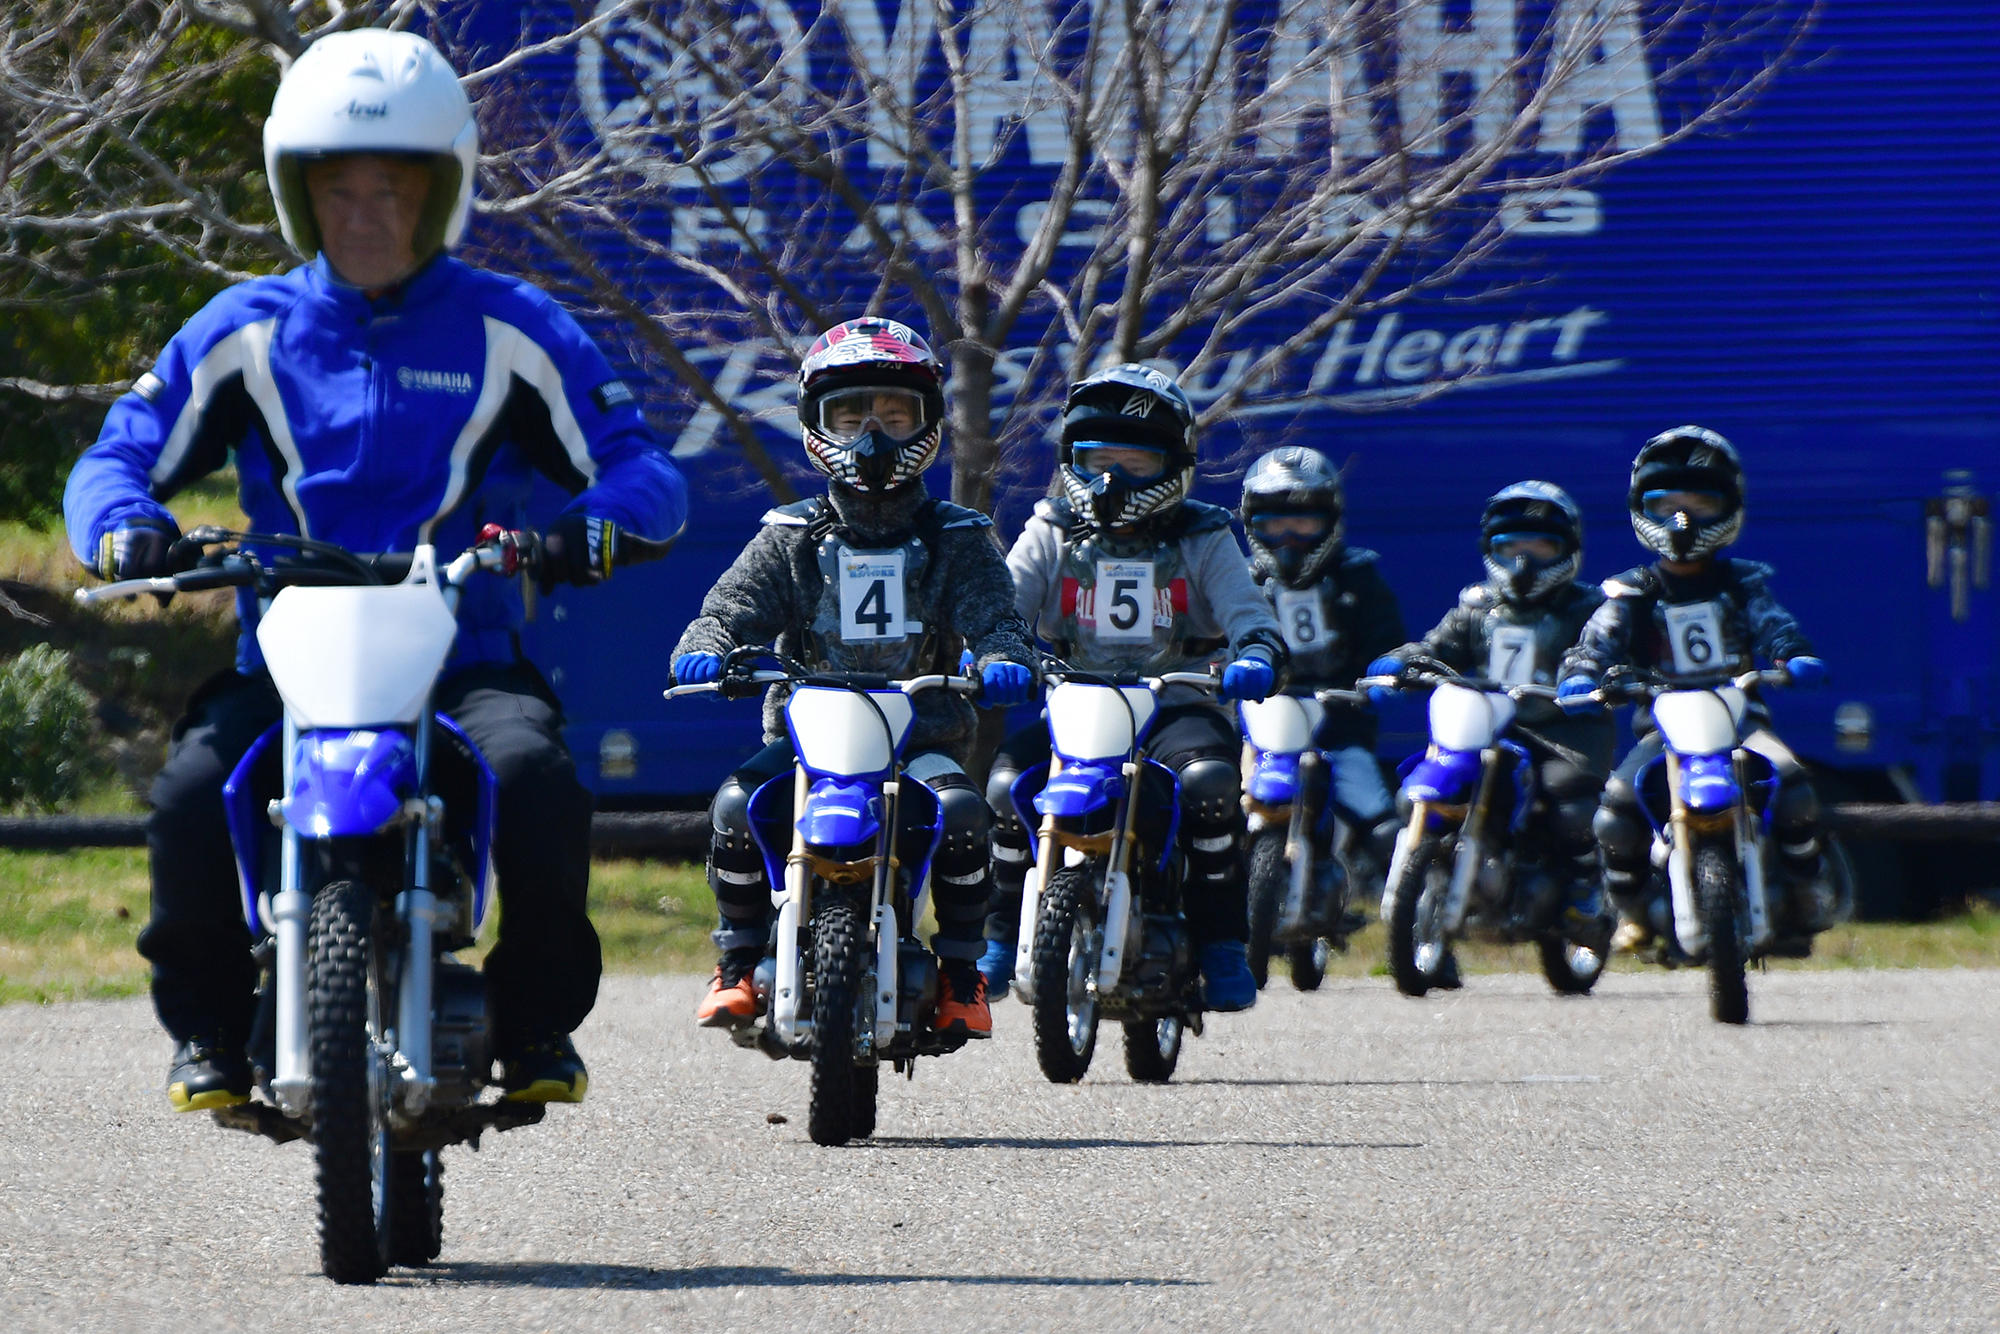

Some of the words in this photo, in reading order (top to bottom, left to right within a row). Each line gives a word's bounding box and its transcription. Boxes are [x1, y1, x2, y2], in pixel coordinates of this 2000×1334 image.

[1309, 304, 1608, 391] Heart
[413, 369, 473, 388] YAMAHA
[854, 579, 893, 636] 4
[1109, 579, 1139, 631] 5
[1295, 607, 1316, 643] 8
[1500, 642, 1522, 681] 7
[1682, 622, 1713, 664] 6
